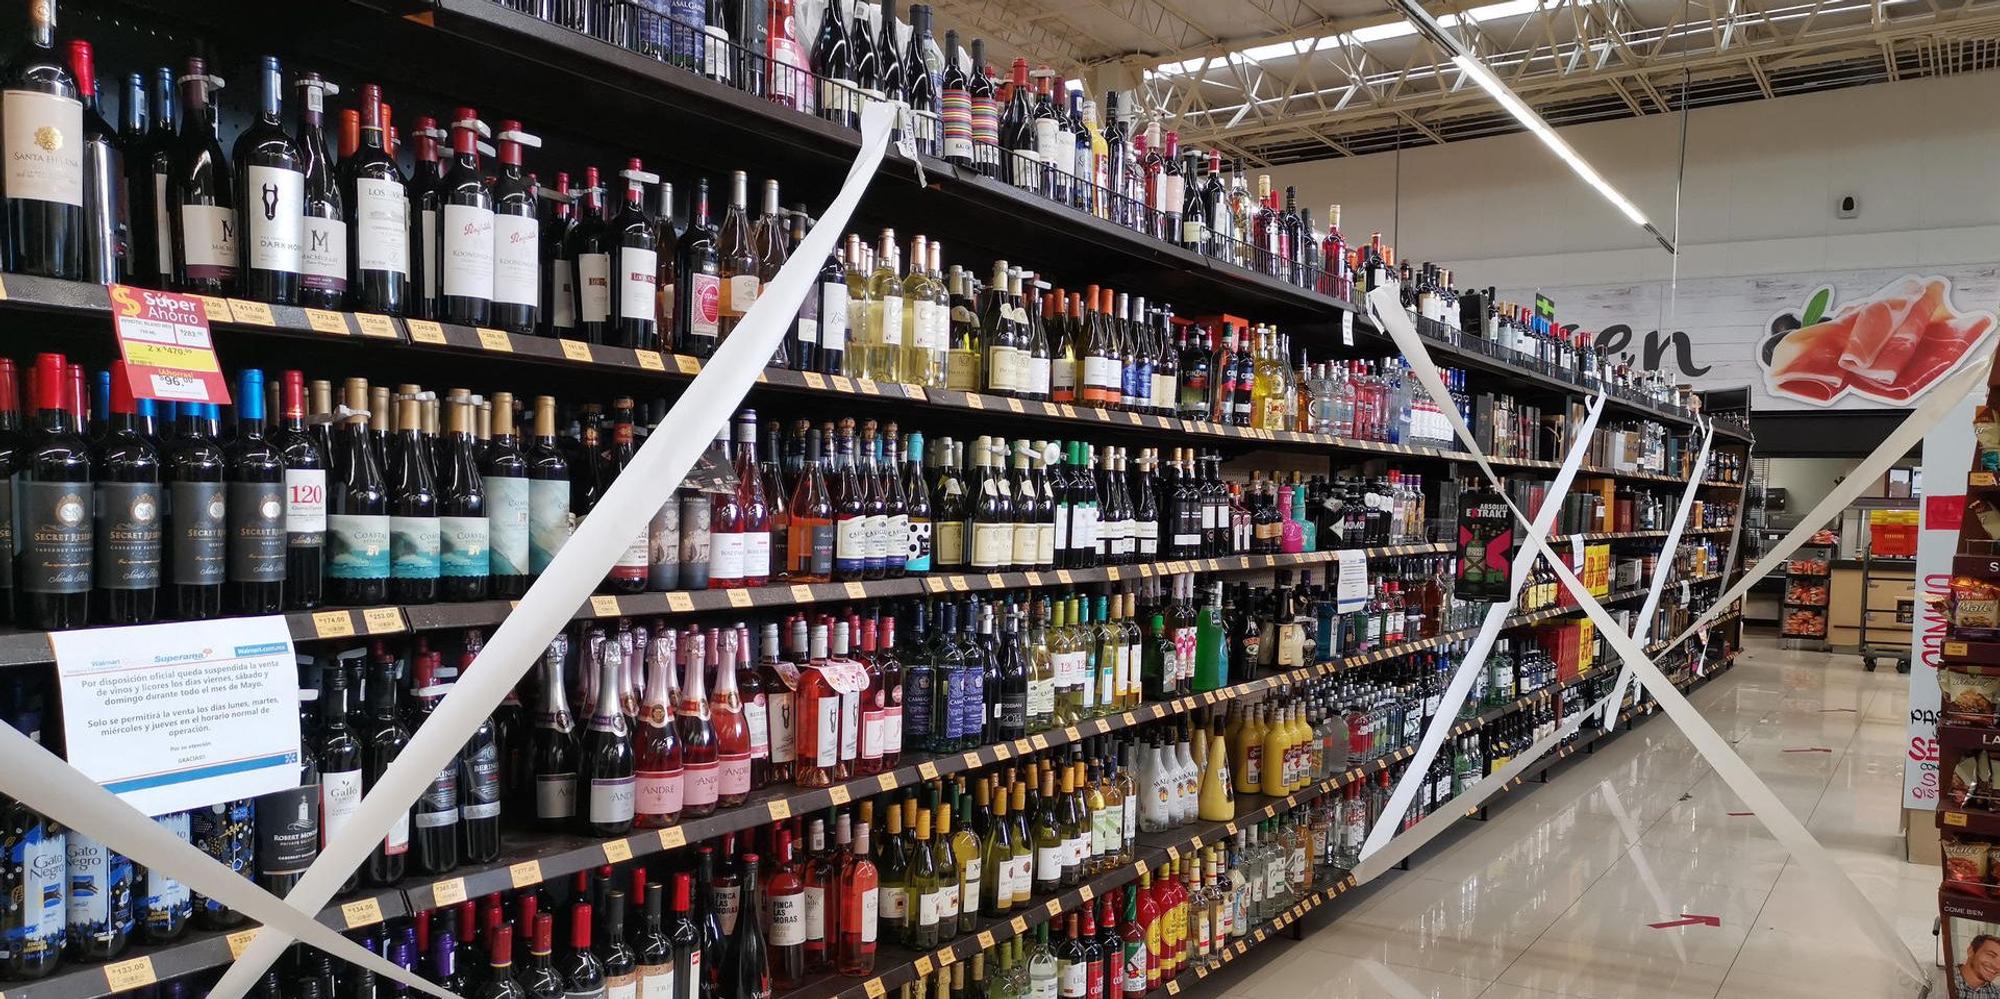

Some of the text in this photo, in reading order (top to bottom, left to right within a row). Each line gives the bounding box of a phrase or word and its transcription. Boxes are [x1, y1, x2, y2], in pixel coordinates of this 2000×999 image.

[311, 229, 329, 252] M
[148, 306, 199, 325] Ahorro
[1561, 324, 1712, 377] en
[290, 484, 322, 504] 120
[34, 532, 69, 542] SECRET
[109, 531, 142, 540] SECRET
[187, 528, 216, 538] SECRET
[239, 527, 270, 537] SECRET
[154, 652, 204, 664] Superama
[81, 660, 280, 688] Por disposición oficial queda suspendida la venta
[96, 688, 108, 697] de
[110, 686, 133, 696] vinos
[135, 686, 141, 695] y
[142, 681, 170, 692] licores
[171, 680, 184, 688] los
[204, 674, 234, 685] viernes,
[235, 671, 263, 681] sábado
[263, 671, 270, 680] y
[104, 680, 265, 706] domingo durante todo el mes de Mayo.
[87, 718, 108, 729] Solo
[109, 717, 120, 726] se
[121, 711, 161, 725] permitirá
[162, 709, 171, 719] la
[172, 707, 195, 717] venta
[196, 704, 209, 714] los
[227, 699, 251, 710] lunes,
[251, 696, 280, 707] martes,
[100, 706, 271, 737] miércoles y jueves en el horario normal de
[168, 725, 211, 738] operación.
[330, 786, 358, 798] Gallo
[274, 833, 299, 841] ROBERT
[66, 843, 98, 858] Gato
[33, 853, 63, 869] Gato
[30, 864, 65, 881] Negro
[773, 900, 793, 910] FINCA
[773, 908, 786, 916] LAS
[1944, 906, 1965, 914] COME
[773, 915, 799, 925] MORAS
